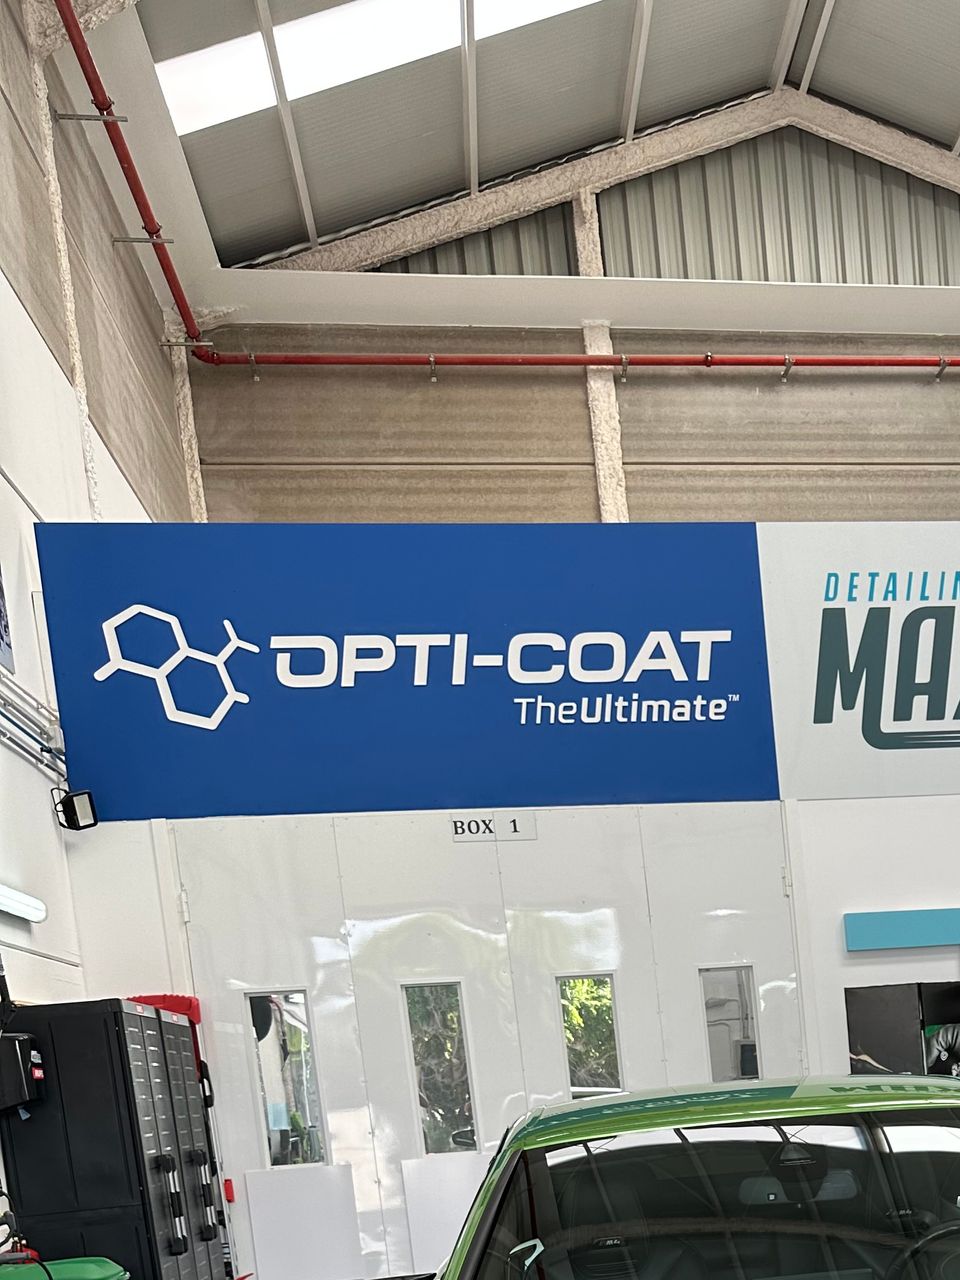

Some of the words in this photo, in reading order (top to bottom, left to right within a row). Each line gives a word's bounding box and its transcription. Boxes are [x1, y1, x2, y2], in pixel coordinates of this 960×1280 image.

[270, 630, 732, 688] OPTI-COAT
[452, 819, 494, 835] BOX
[510, 818, 520, 834] 1
